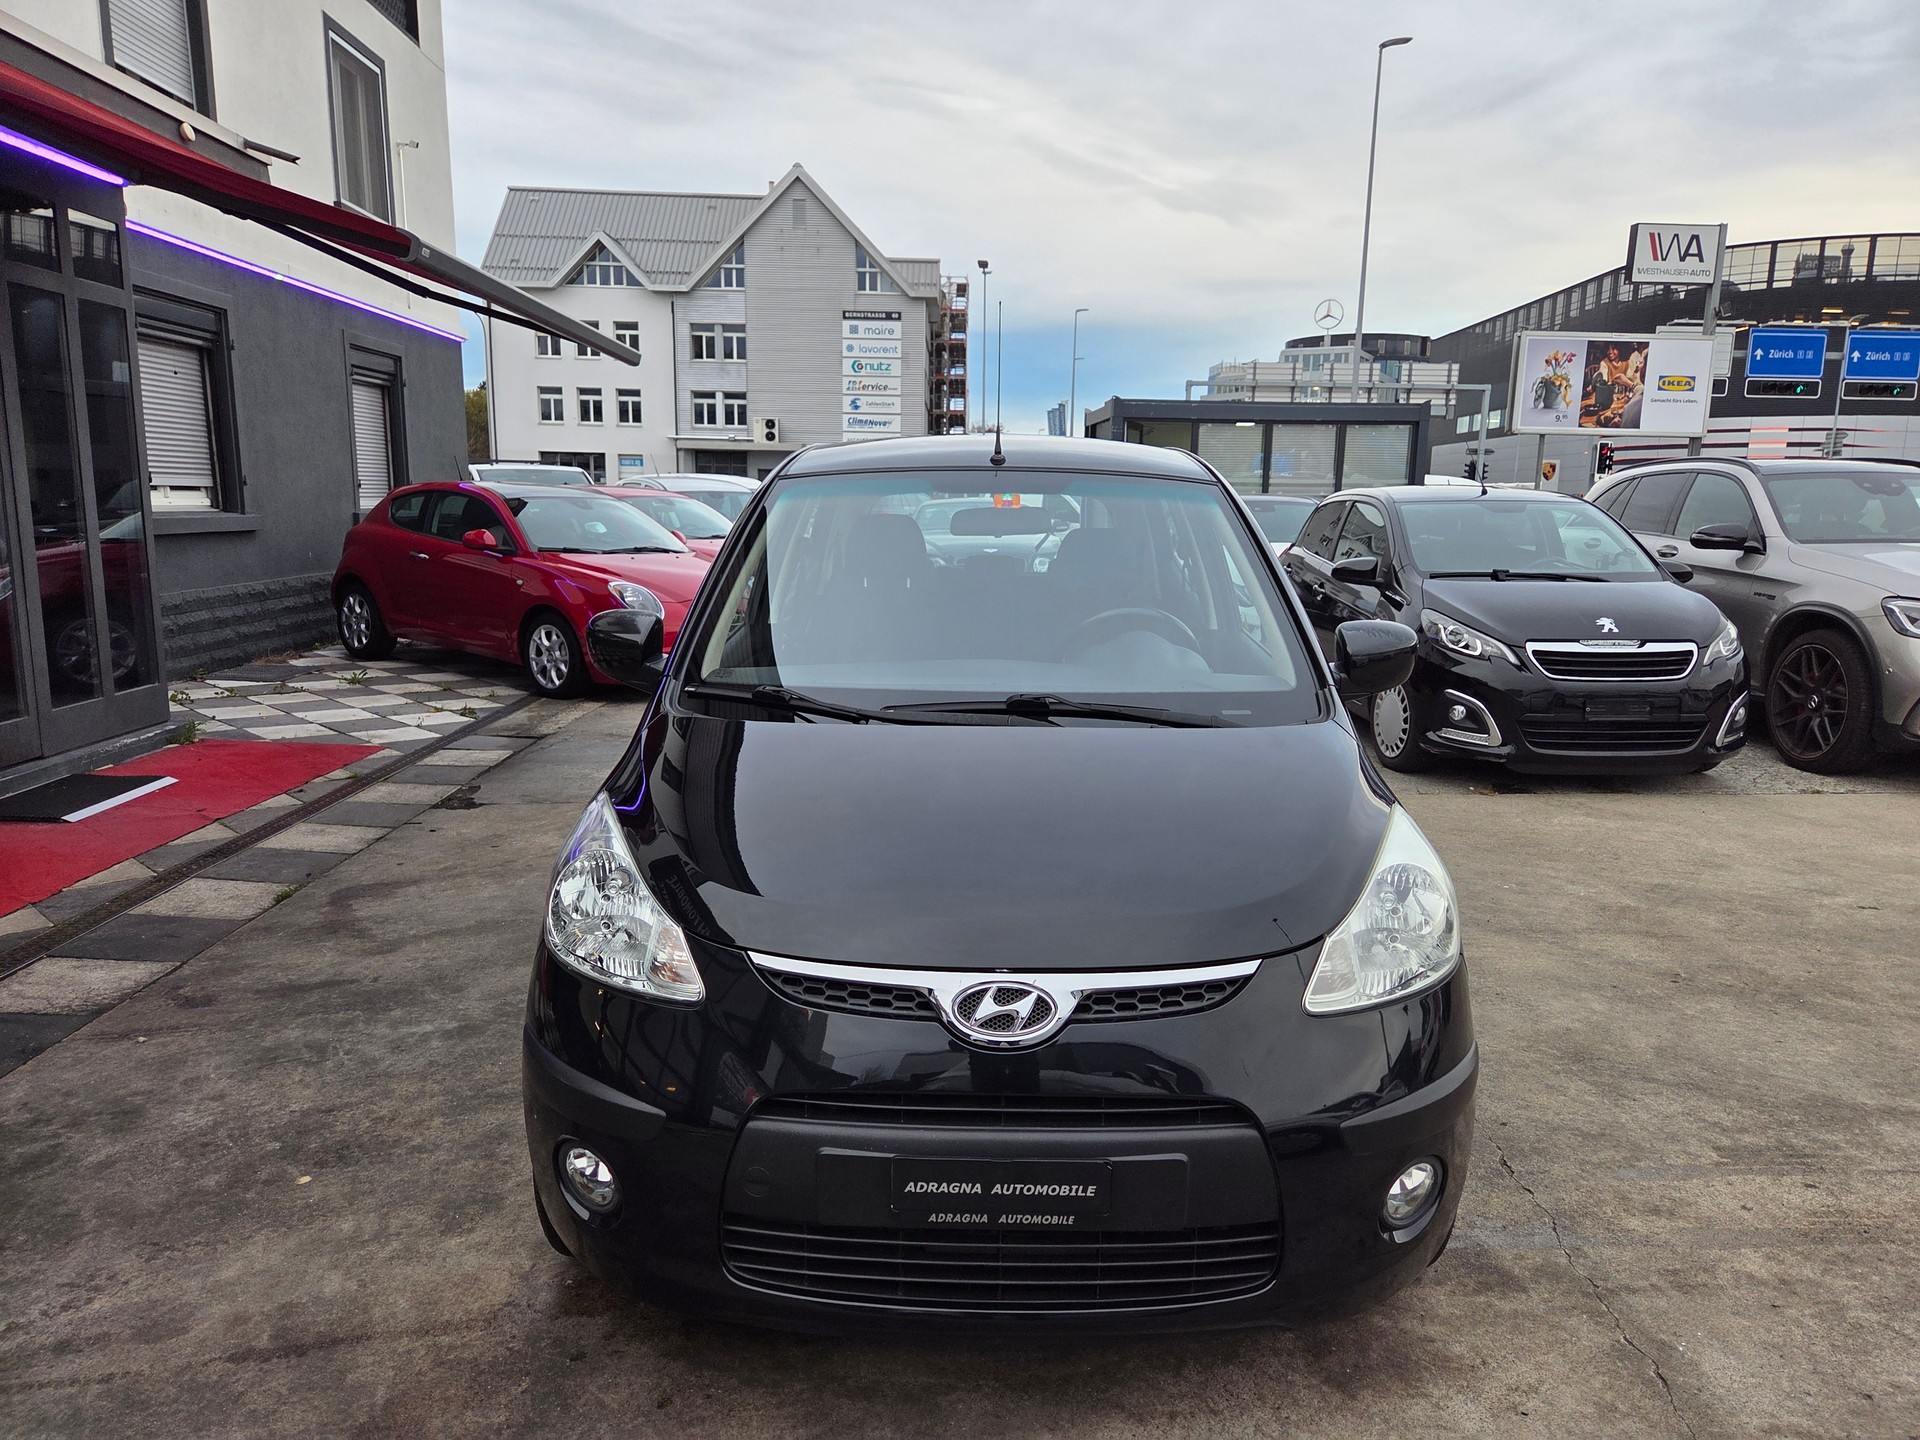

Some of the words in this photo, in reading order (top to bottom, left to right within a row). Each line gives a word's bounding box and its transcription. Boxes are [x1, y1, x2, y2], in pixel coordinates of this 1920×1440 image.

[864, 325, 895, 335] maire
[859, 344, 898, 354] lavorent
[1769, 349, 1794, 359] Zürich
[1865, 351, 1891, 361] Zürich
[904, 1181, 982, 1194] ADRAGNA
[990, 1183, 1097, 1197] AUTOMOBILE
[928, 1212, 988, 1223] ADRAGNA
[998, 1213, 1075, 1225] AUTOMOBILE
